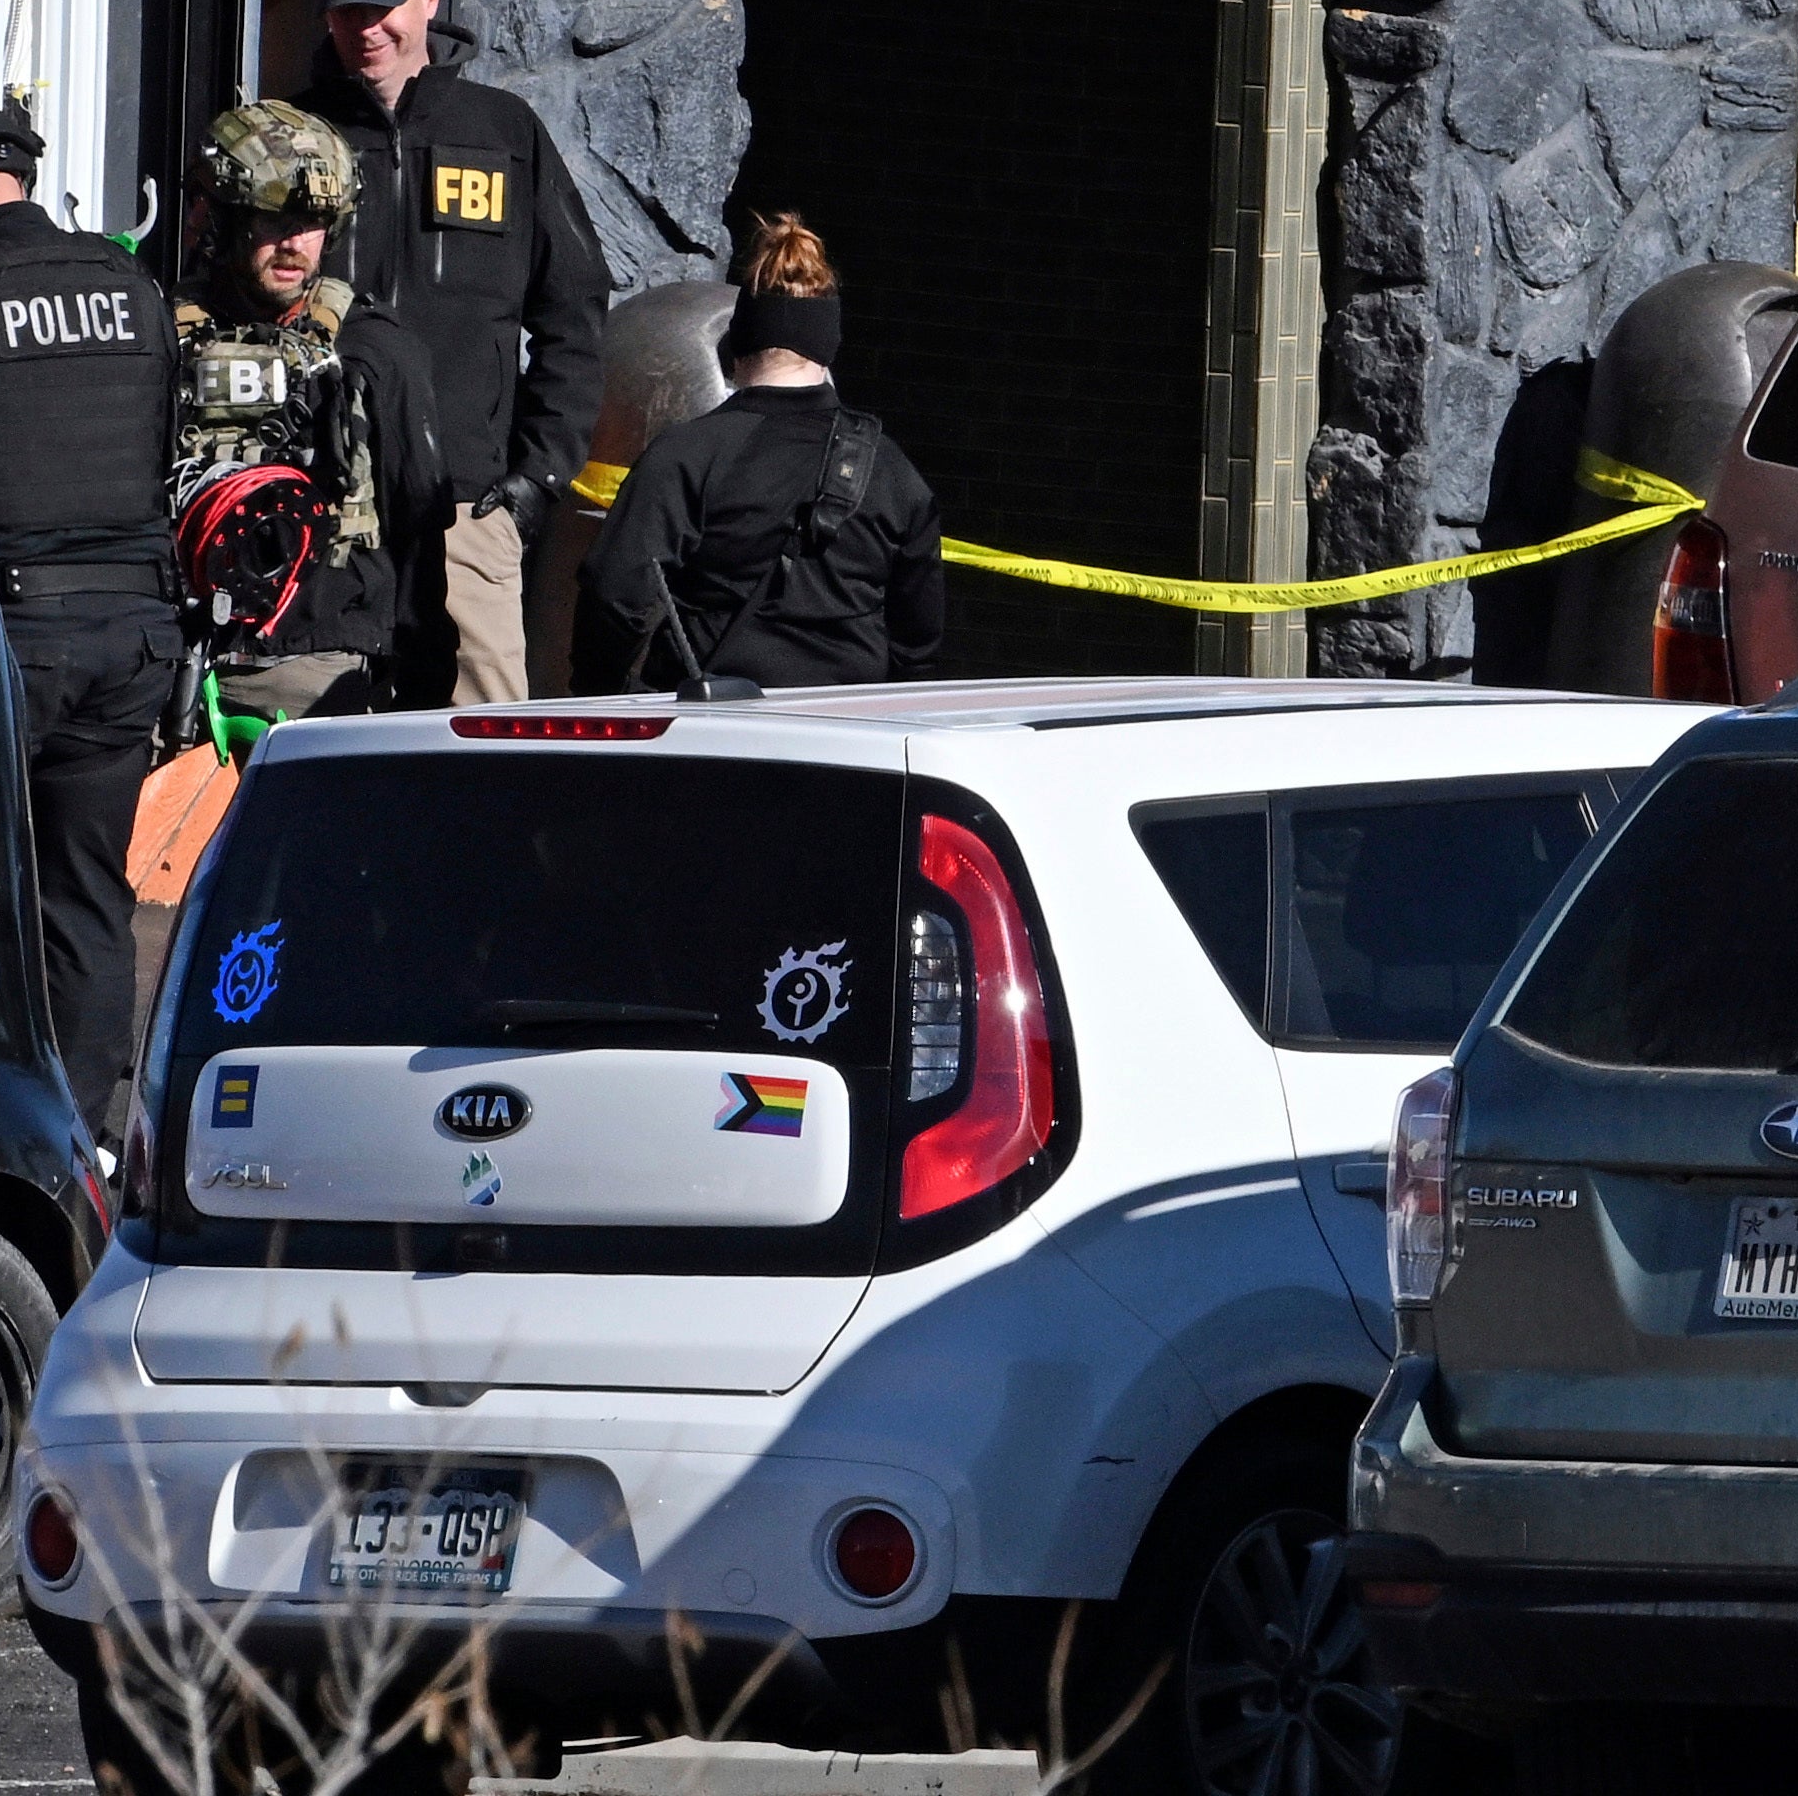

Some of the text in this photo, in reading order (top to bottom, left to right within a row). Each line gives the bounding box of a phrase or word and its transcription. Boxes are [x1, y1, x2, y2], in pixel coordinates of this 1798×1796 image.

[436, 165, 505, 222] FBI
[1, 292, 135, 348] POLICE
[196, 357, 287, 403] FBI
[453, 1094, 513, 1128] KIA
[201, 1162, 288, 1191] SOUL
[1467, 1186, 1578, 1209] SUBARU
[1492, 1217, 1538, 1229] AWD
